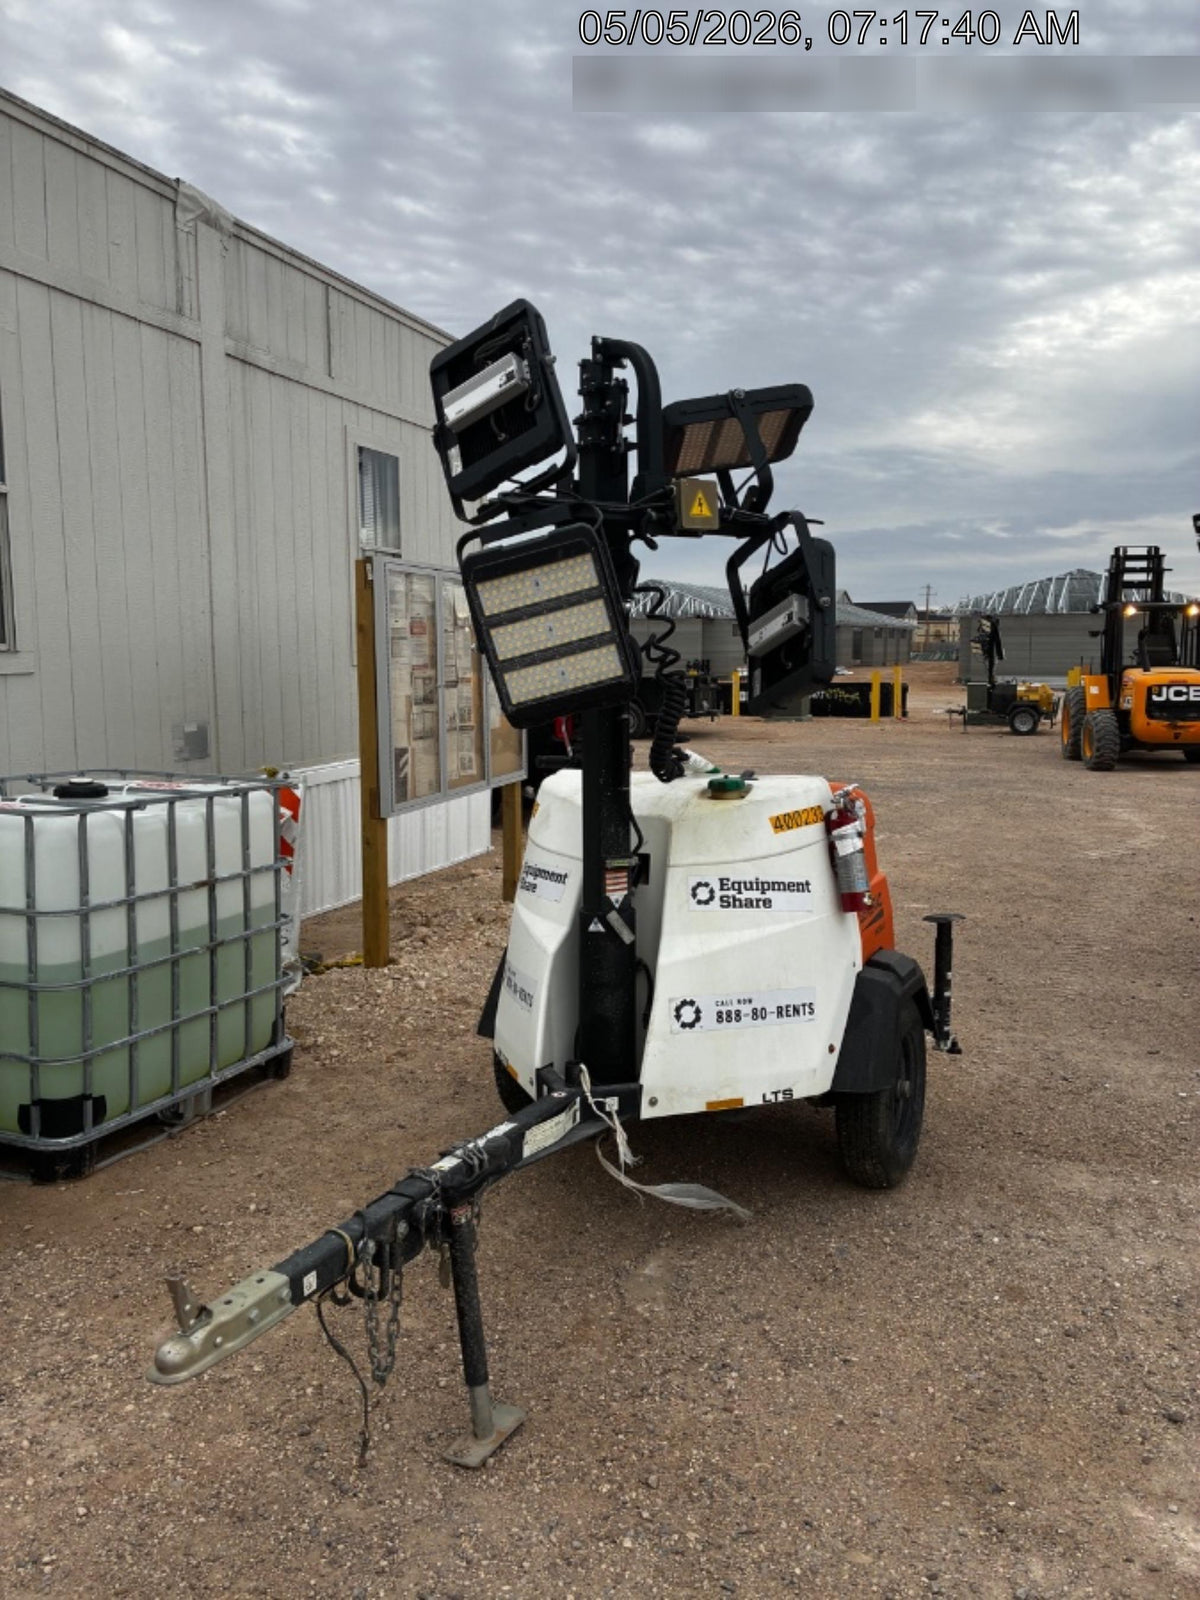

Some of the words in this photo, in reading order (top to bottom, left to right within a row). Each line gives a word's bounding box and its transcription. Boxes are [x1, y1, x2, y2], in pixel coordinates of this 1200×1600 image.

[718, 878, 811, 895] Equipment
[719, 894, 772, 909] Share
[715, 999, 733, 1007] CALL
[716, 1002, 815, 1024] 888-80-RENTS
[762, 1087, 794, 1103] LTS
